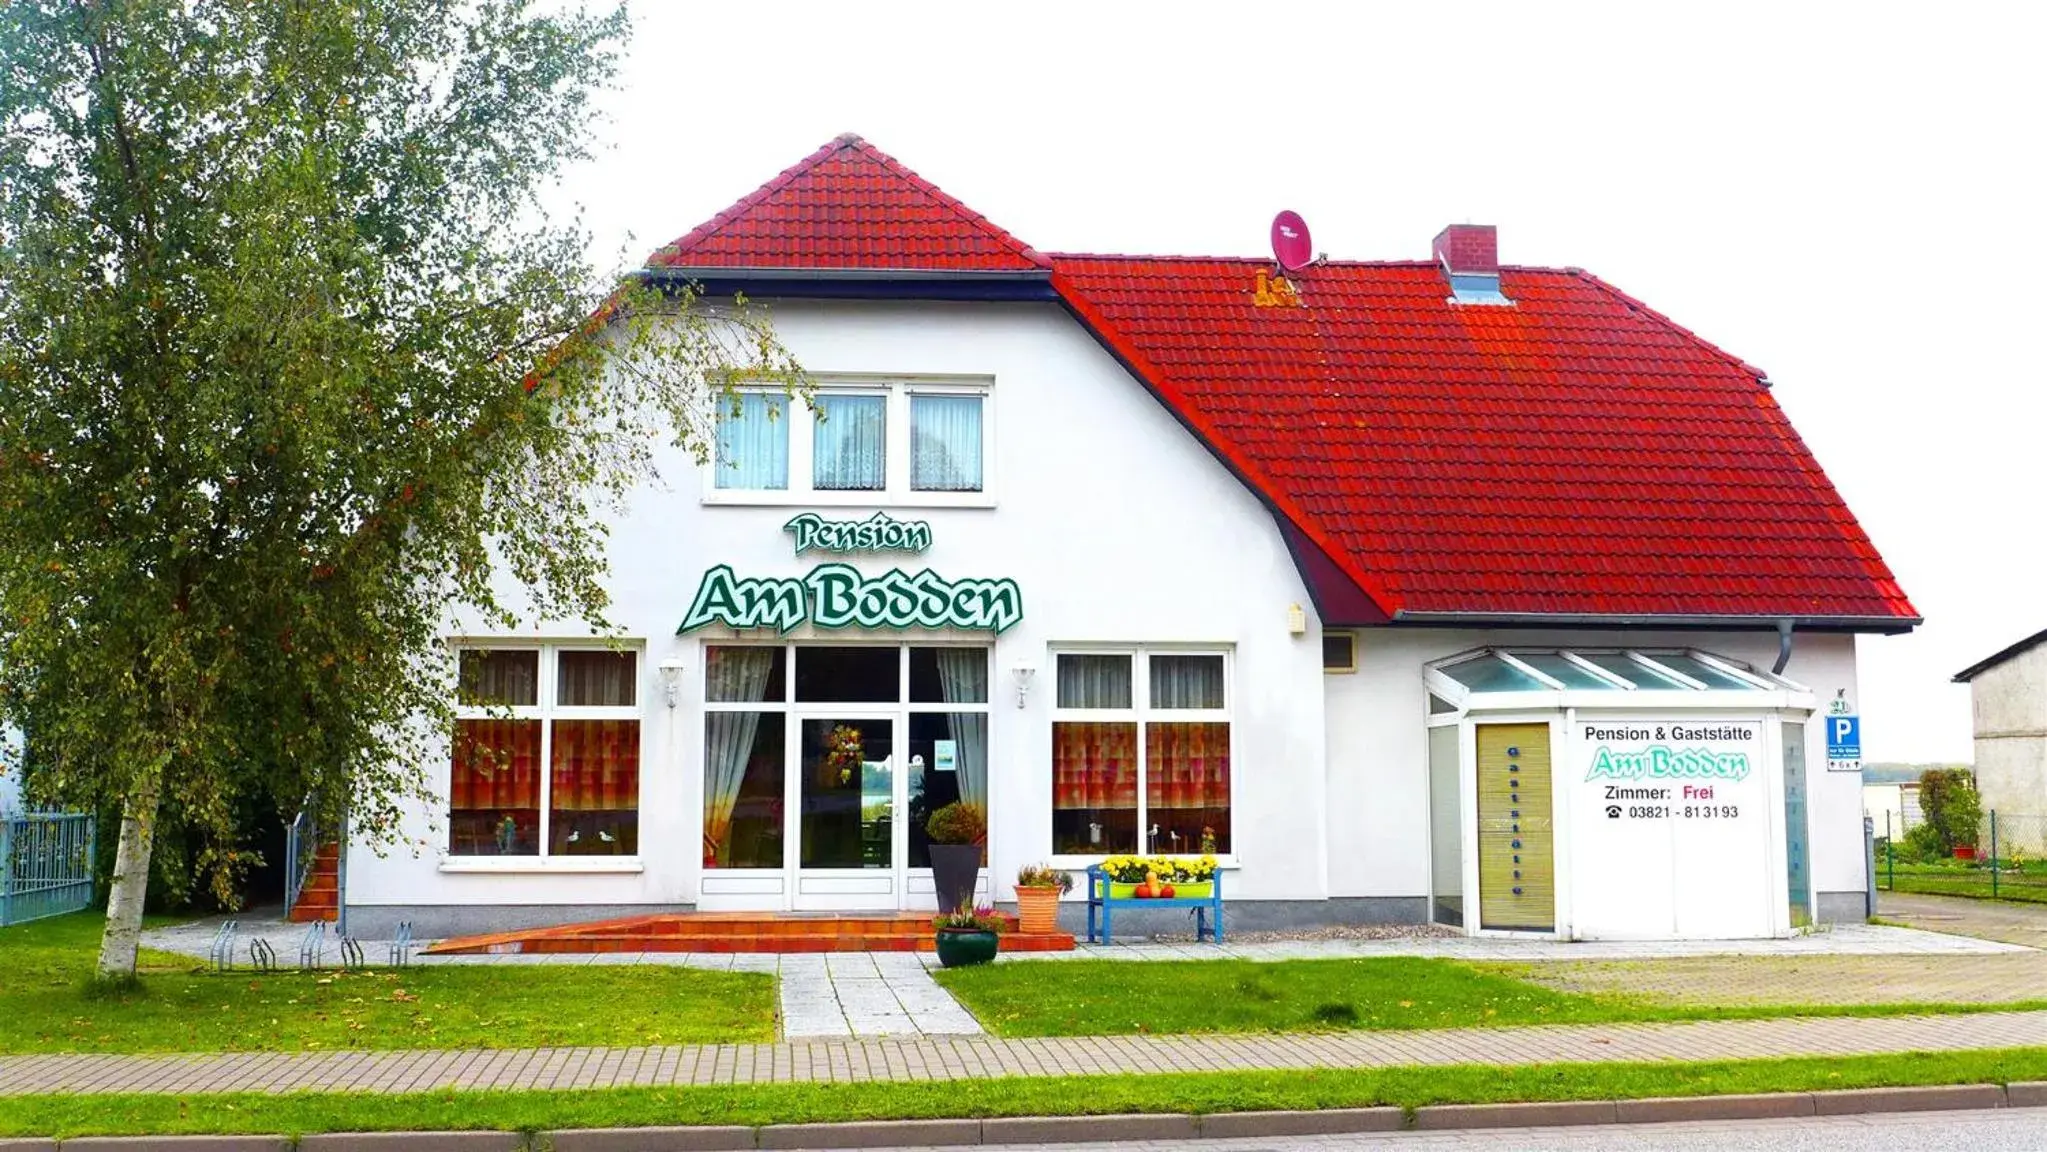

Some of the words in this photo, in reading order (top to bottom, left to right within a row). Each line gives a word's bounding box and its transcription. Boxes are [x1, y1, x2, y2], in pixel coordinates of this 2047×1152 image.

[788, 513, 932, 551] Pension
[688, 567, 804, 631] Am
[809, 566, 1018, 630] Bodden
[1585, 727, 1650, 741] Pension
[1655, 727, 1666, 741] &
[1671, 726, 1752, 741] Gaststätte
[1836, 719, 1852, 744] P
[1589, 748, 1645, 778] Am
[1648, 746, 1749, 778] Bodden
[1604, 786, 1671, 800] Zimmer:
[1683, 786, 1714, 800] Frei
[1629, 806, 1670, 819] 03821
[1684, 806, 1739, 819] 813193
